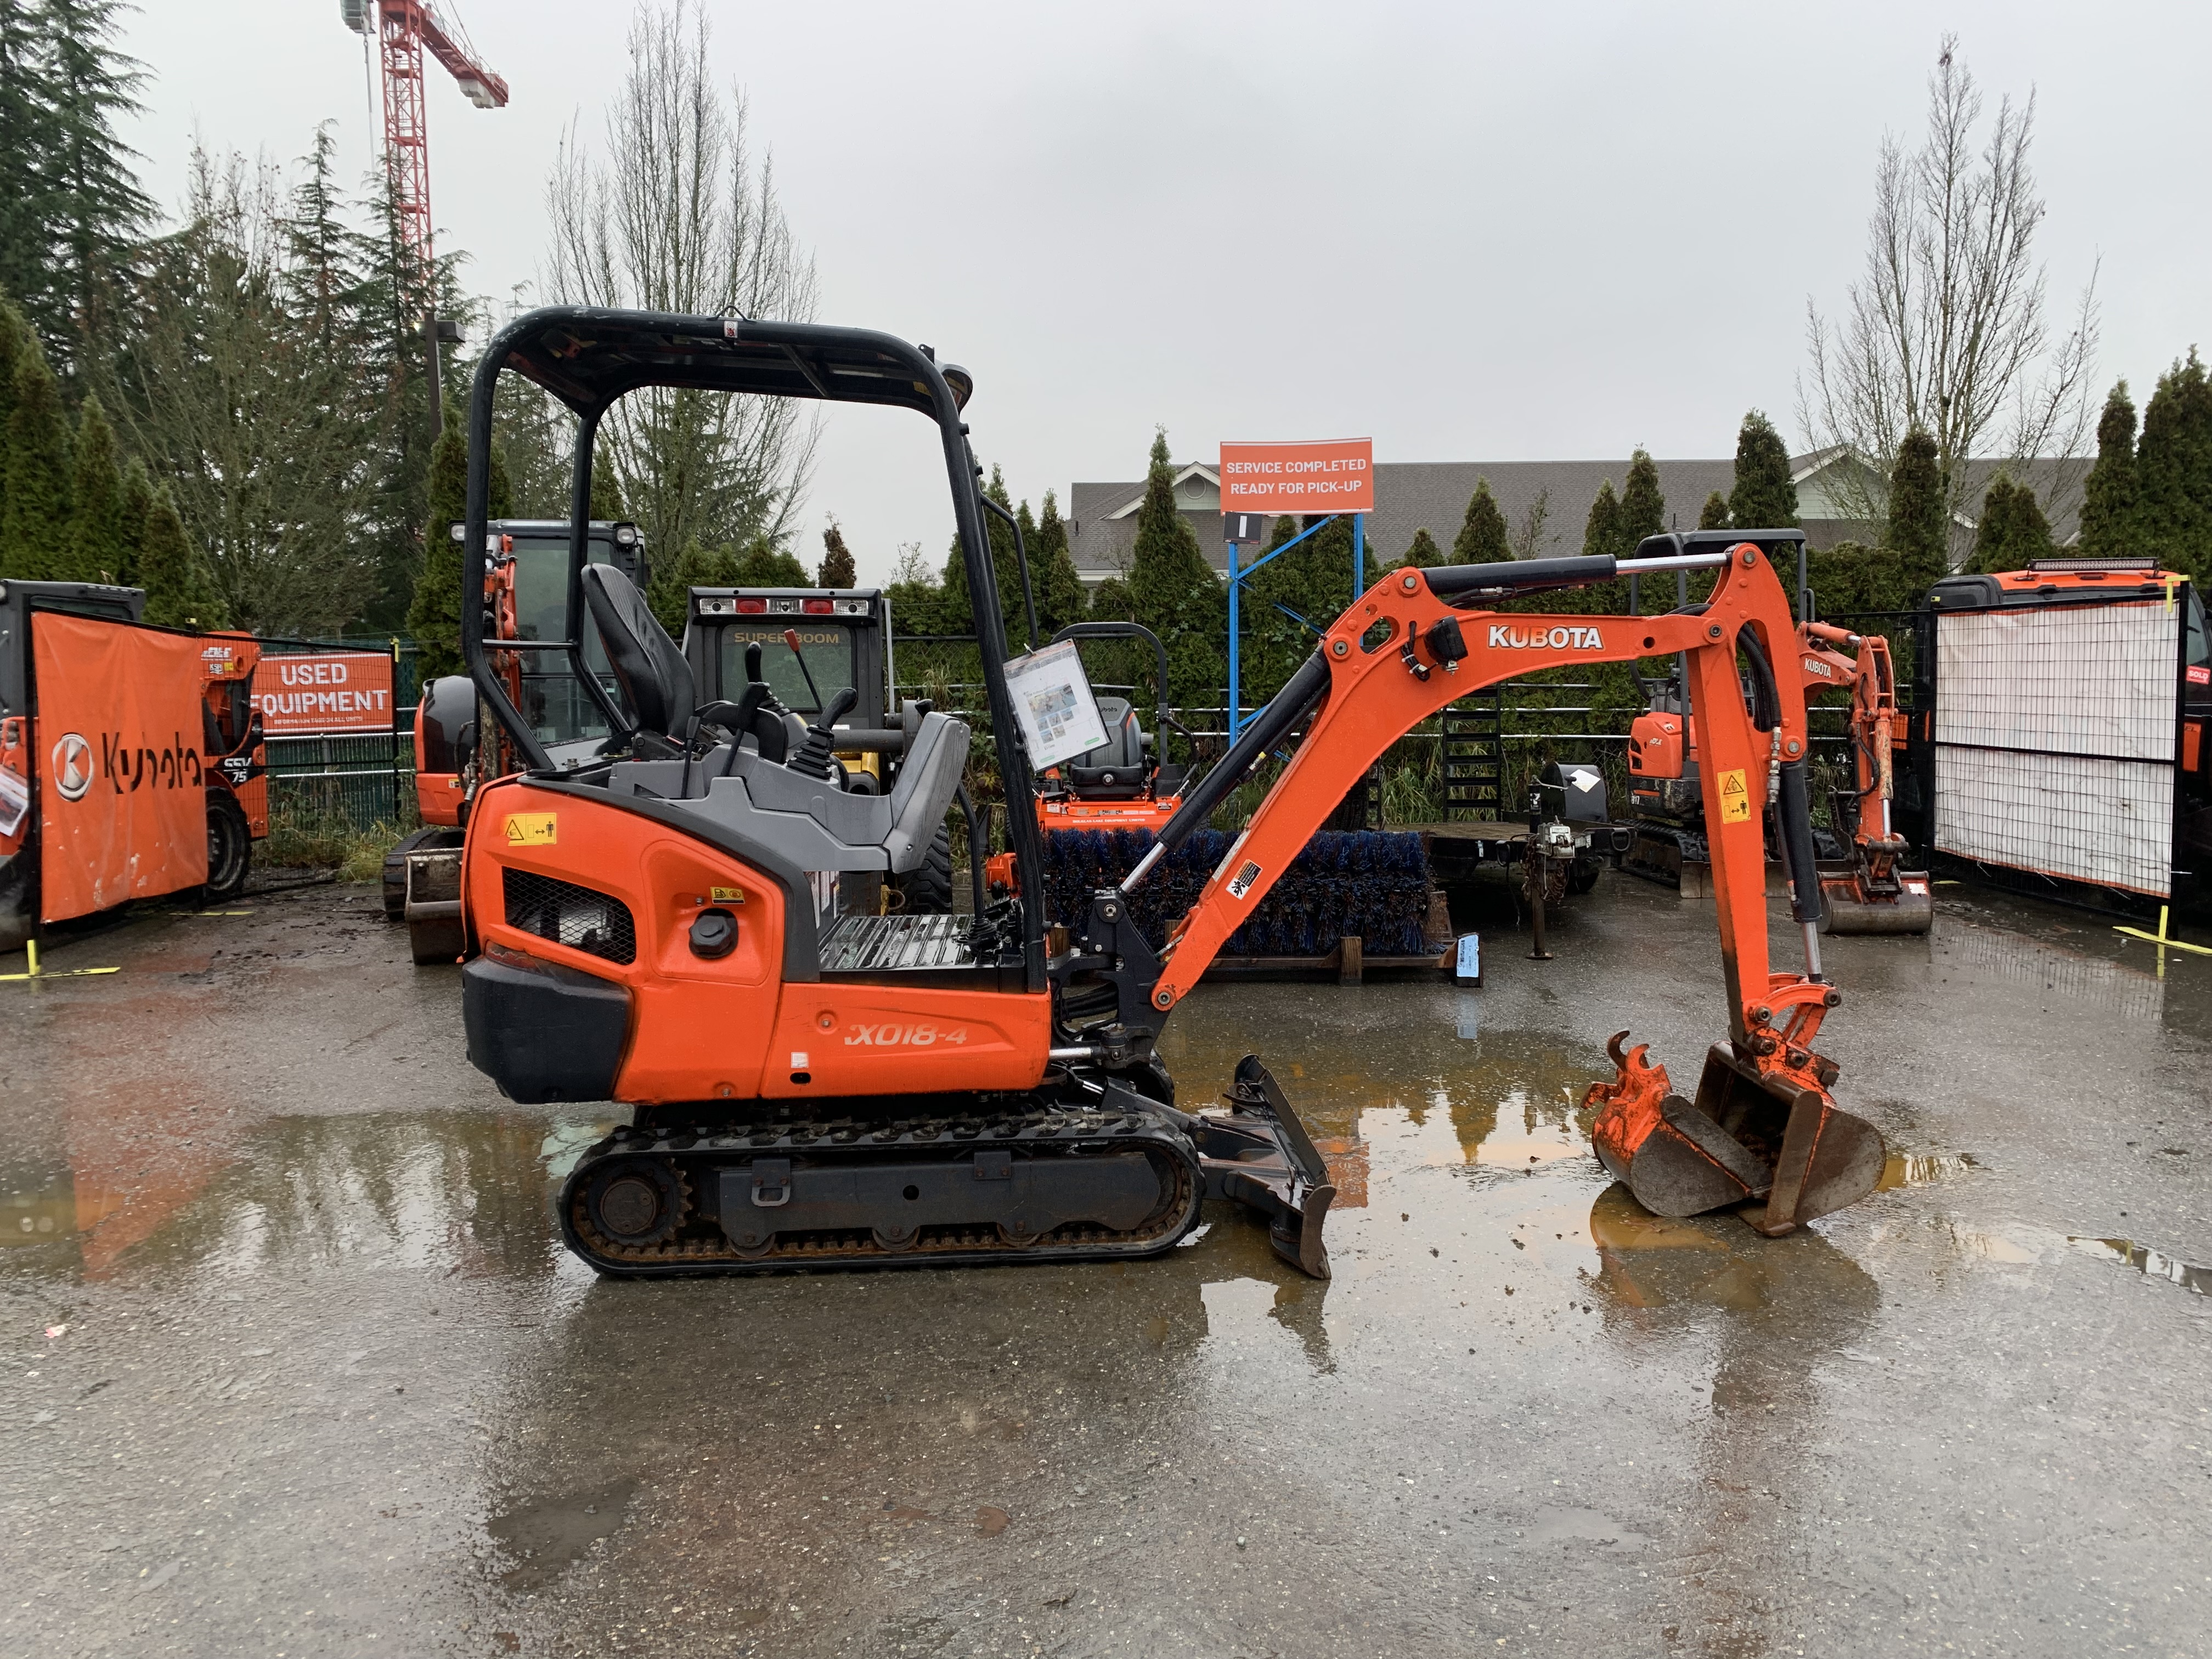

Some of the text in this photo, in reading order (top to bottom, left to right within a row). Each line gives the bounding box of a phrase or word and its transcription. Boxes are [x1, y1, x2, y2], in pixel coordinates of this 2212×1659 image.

[1226, 458, 1367, 473] SERVICE COMPLETED
[1231, 480, 1362, 494] READY FOR PICK-UP
[734, 632, 788, 643] SUPER
[1488, 625, 1604, 649] KUBOTA
[280, 663, 347, 686] USED
[1804, 658, 1831, 678] KUBOTA
[2188, 670, 2209, 679] SOLD
[250, 689, 388, 717] EQUIPMENT
[232, 771, 247, 783] 75
